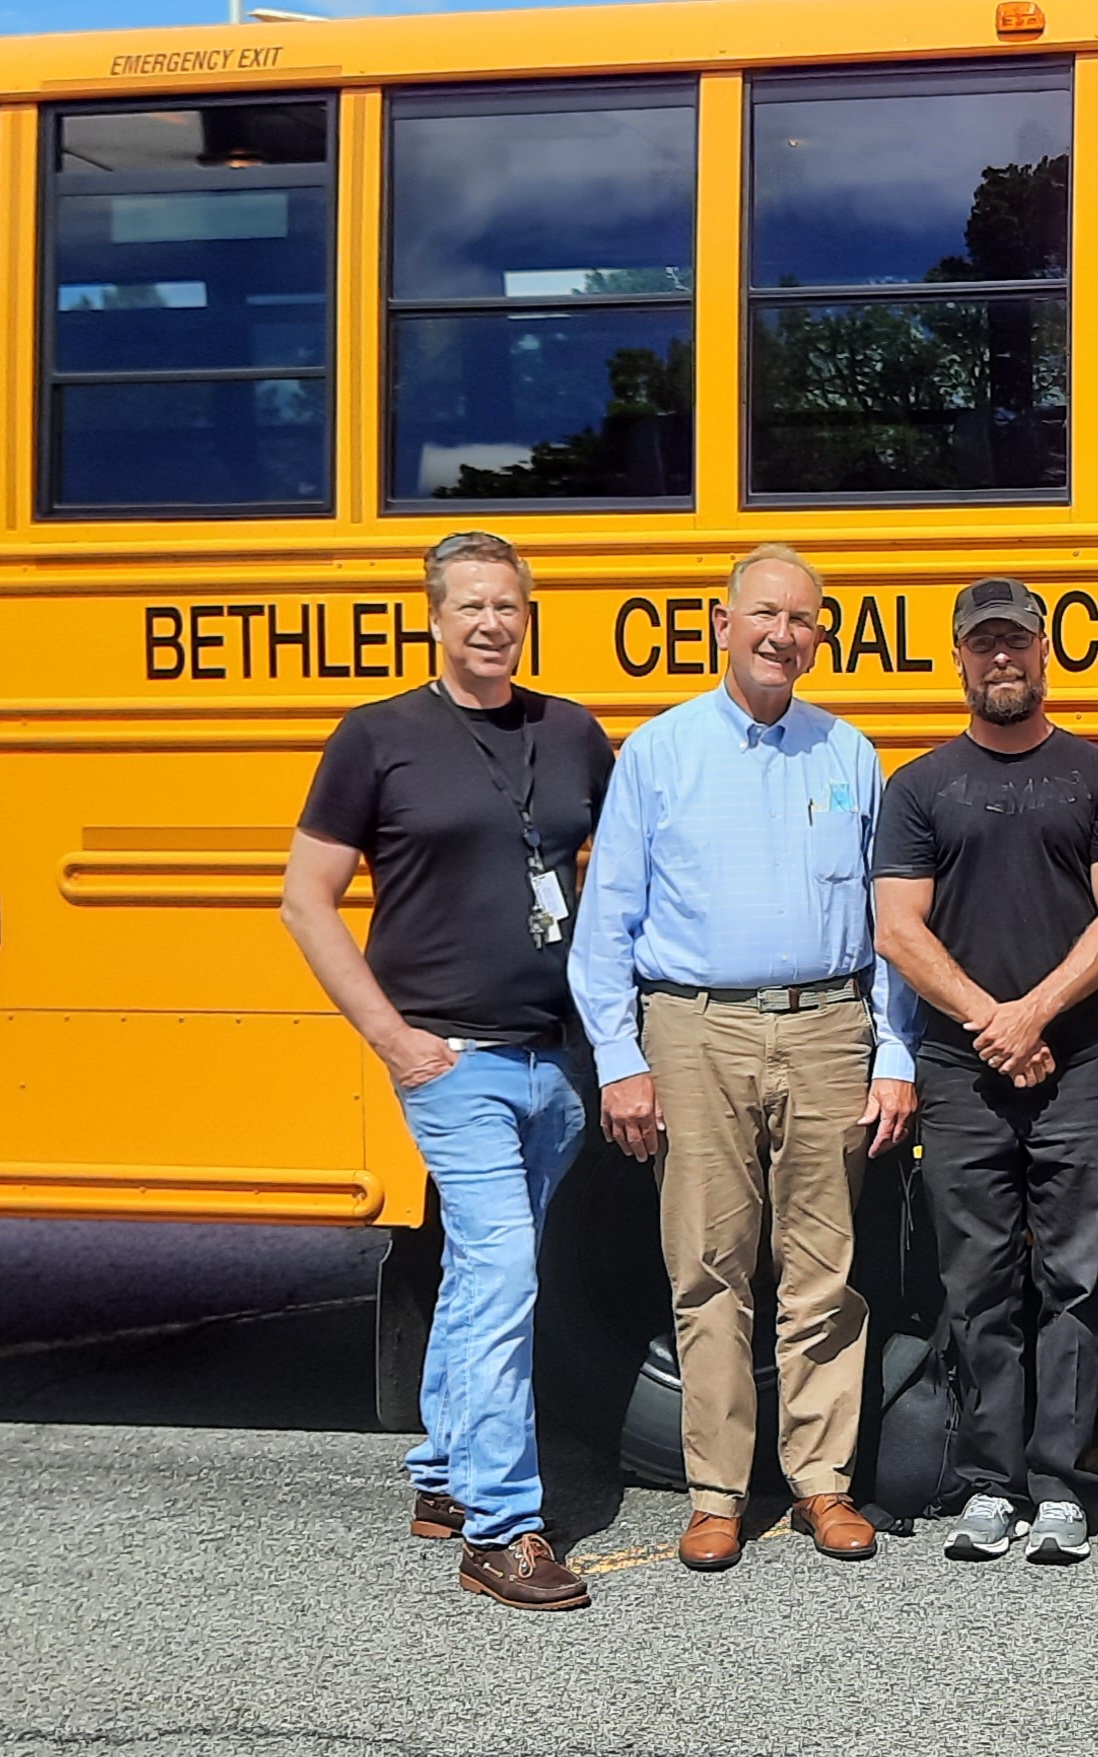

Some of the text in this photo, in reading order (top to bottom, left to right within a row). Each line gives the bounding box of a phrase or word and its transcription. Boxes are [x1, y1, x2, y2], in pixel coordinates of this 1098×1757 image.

[110, 46, 283, 75] EMERGENCY EXIT
[144, 600, 540, 681] BETHLEH
[614, 594, 933, 678] CERAL
